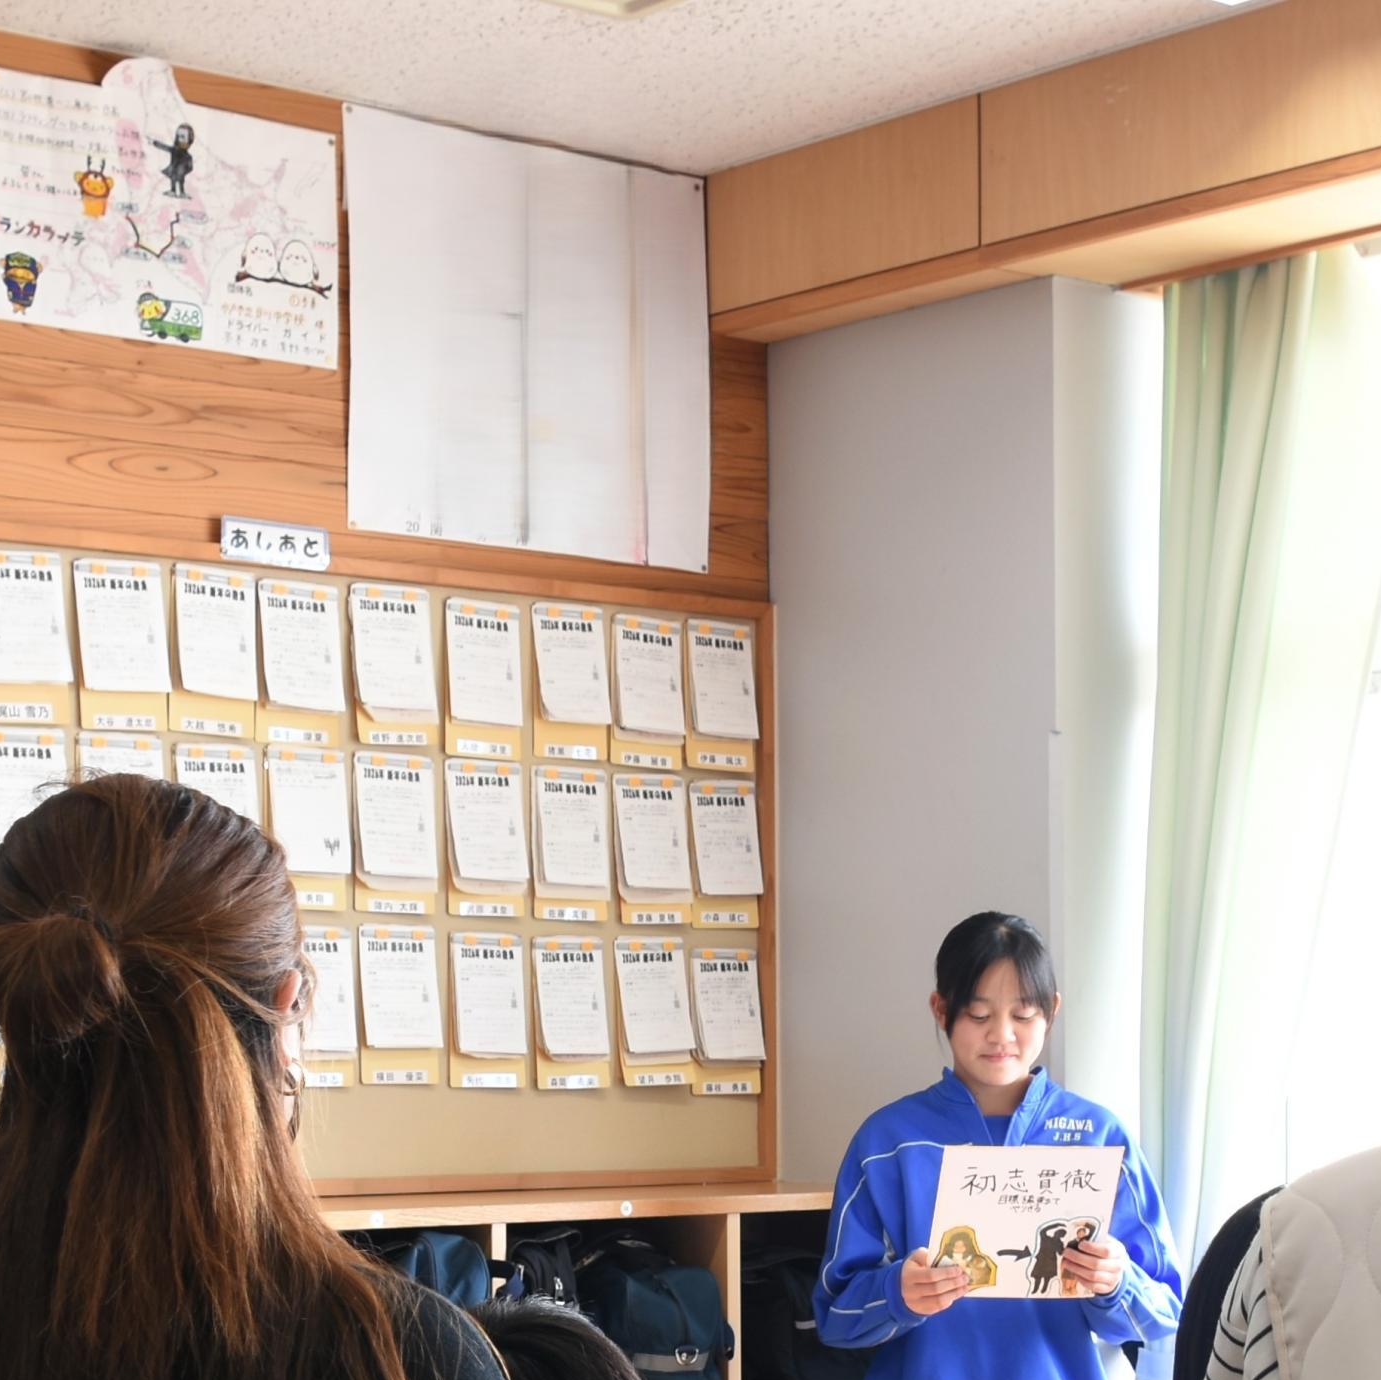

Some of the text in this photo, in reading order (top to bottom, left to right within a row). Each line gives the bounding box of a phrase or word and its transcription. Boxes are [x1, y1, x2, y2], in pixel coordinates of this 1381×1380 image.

[172, 308, 200, 326] 368
[230, 528, 320, 559] あしあと
[25, 705, 48, 719] 雪乃
[960, 1166, 1103, 1197] 初志貫徹
